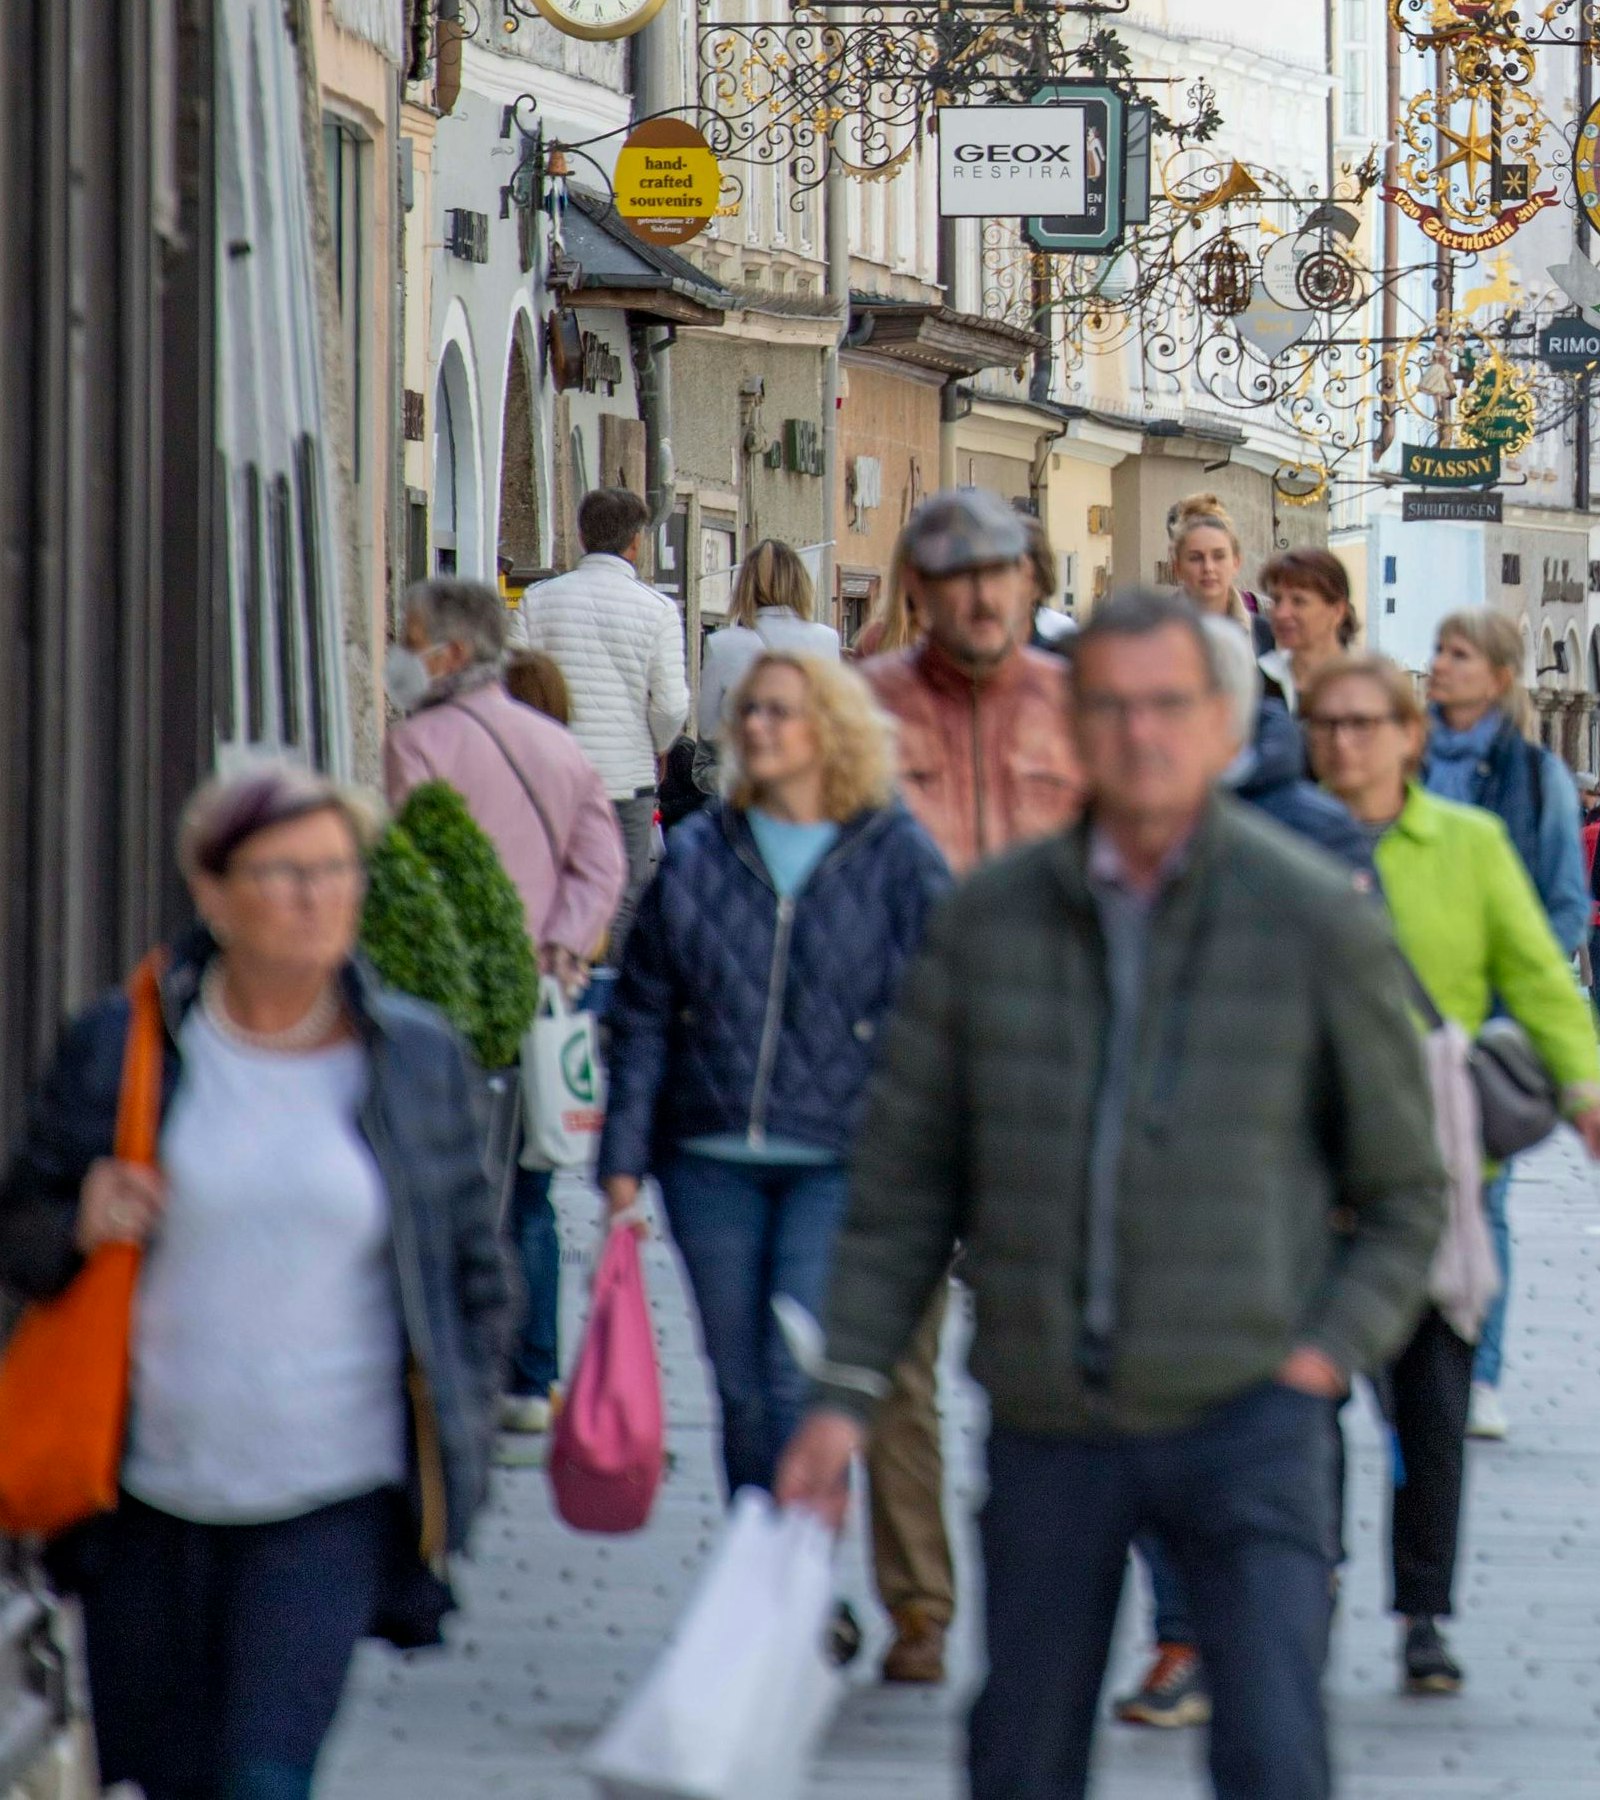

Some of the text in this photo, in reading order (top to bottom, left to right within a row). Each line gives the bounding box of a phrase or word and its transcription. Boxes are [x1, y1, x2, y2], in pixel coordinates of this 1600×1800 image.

[954, 144, 1071, 163] GEOX
[644, 156, 688, 171] hand-
[953, 165, 1072, 179] RESPIRA
[639, 174, 694, 189] crafted
[629, 193, 703, 208] souvenirs
[1423, 216, 1516, 250] Sternbräu
[1409, 455, 1493, 478] STASSNY
